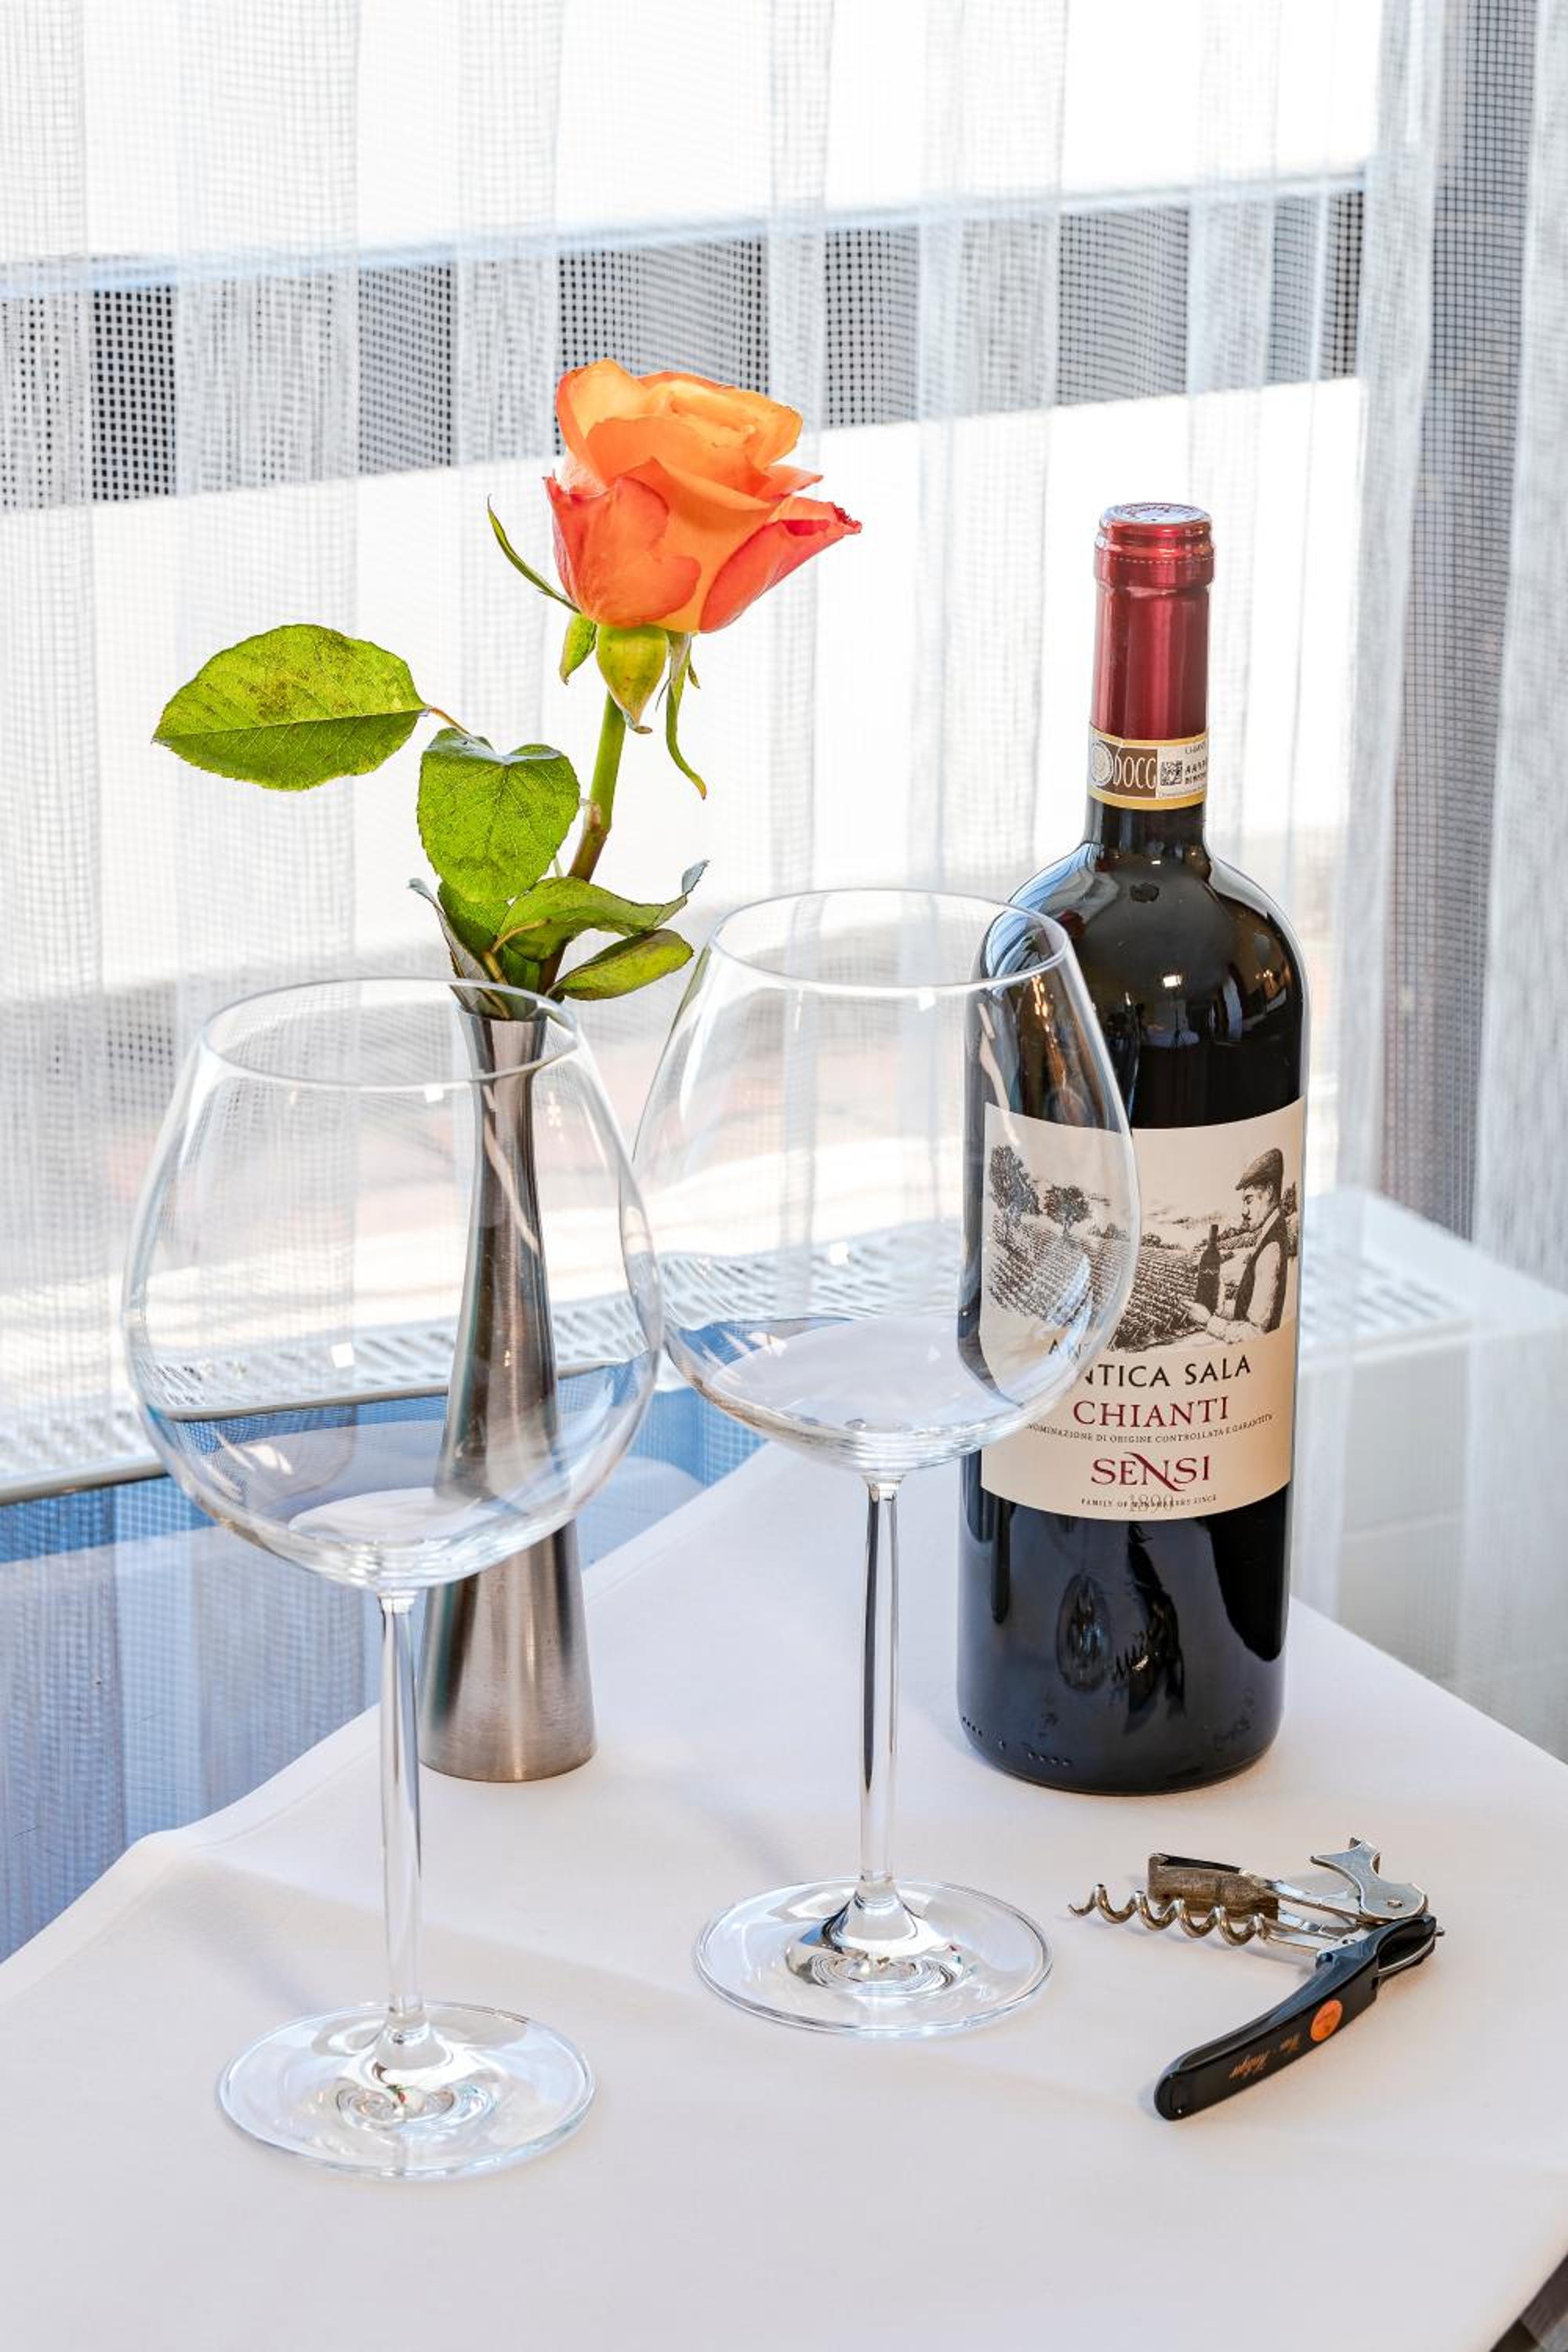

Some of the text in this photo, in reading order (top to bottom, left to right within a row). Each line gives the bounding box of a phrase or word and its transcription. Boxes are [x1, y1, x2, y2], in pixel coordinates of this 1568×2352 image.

[1185, 1355, 1251, 1386] SALA
[1073, 1396, 1229, 1428] CHIANTI
[1109, 1434, 1152, 1443] ORIGINE
[1155, 1429, 1224, 1443] CONTROLLATA
[1225, 1426, 1230, 1435] E
[1091, 1451, 1210, 1492] SENSI
[1081, 1498, 1112, 1508] FAMILY
